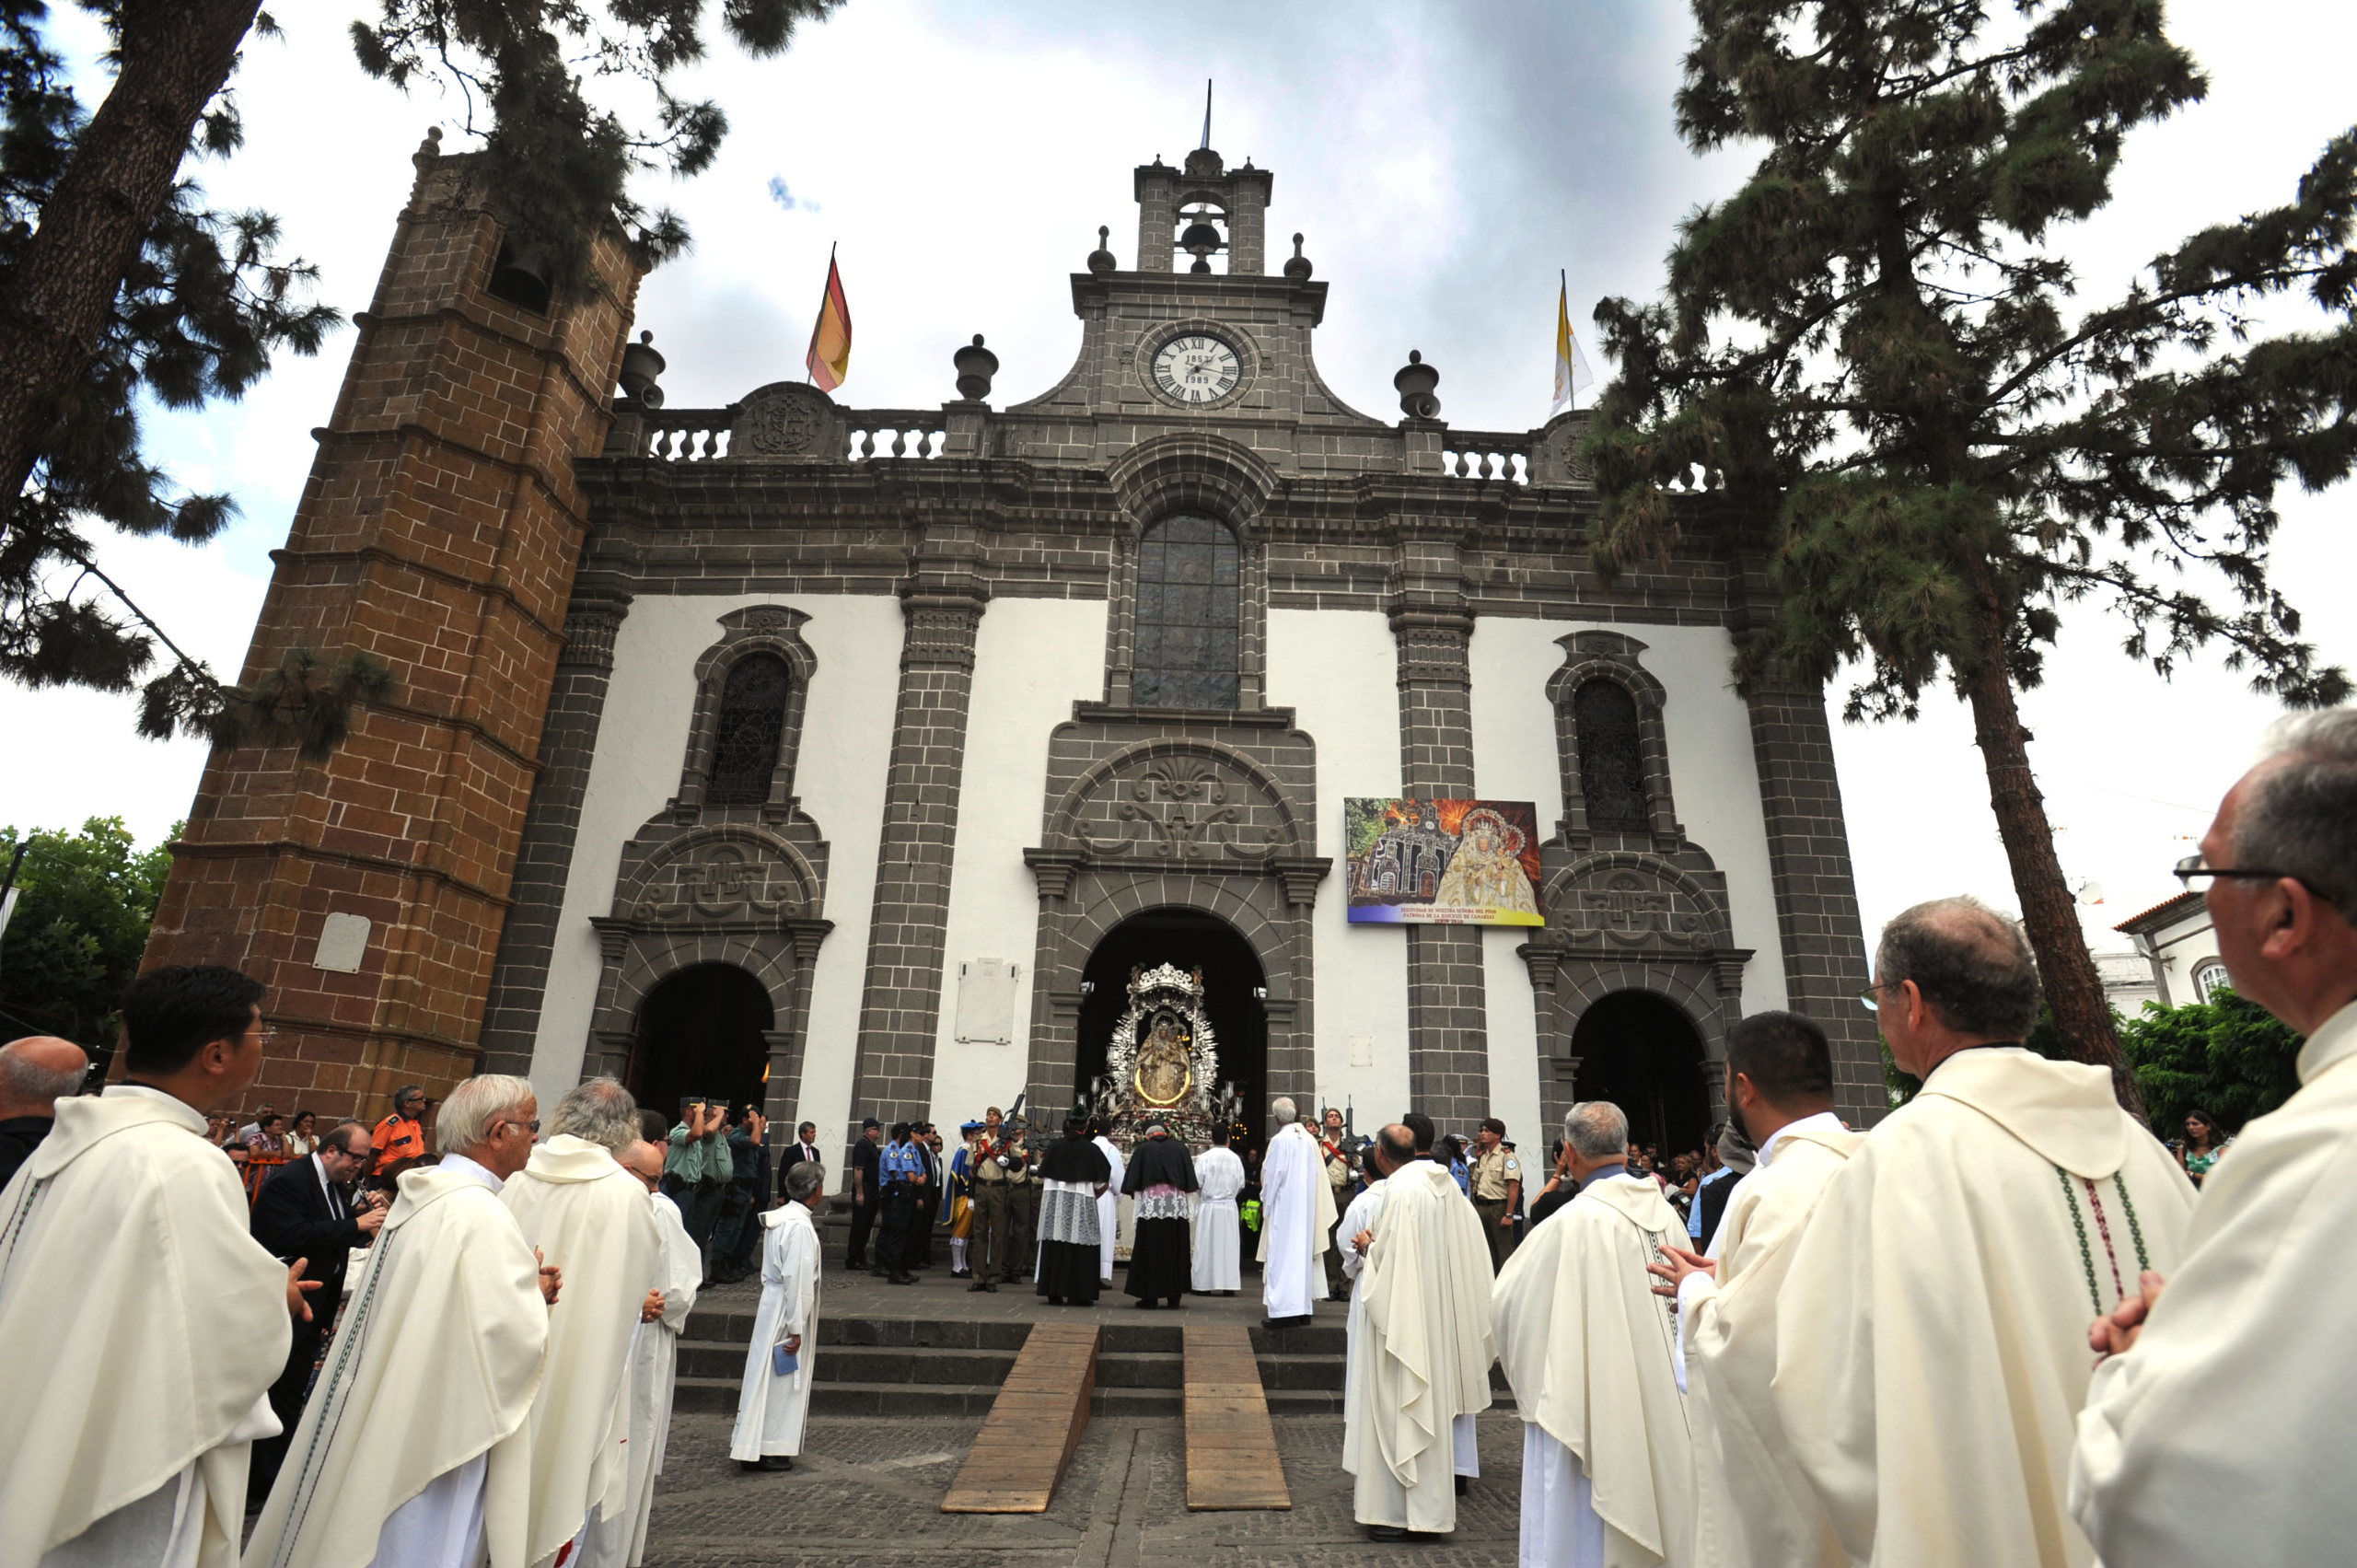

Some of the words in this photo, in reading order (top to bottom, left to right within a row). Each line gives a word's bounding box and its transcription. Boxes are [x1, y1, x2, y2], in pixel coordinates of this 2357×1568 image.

[1173, 339, 1189, 353] XI
[1190, 338, 1205, 349] XII
[1209, 342, 1219, 353] I
[1161, 350, 1177, 360] X
[1219, 352, 1233, 362] II
[1157, 364, 1171, 373] IX
[1223, 366, 1237, 376] III
[1159, 374, 1176, 389] VIII
[1216, 376, 1234, 391] IIII
[1170, 384, 1187, 398] VII
[1190, 390, 1202, 401] VI
[1208, 388, 1220, 400] V
